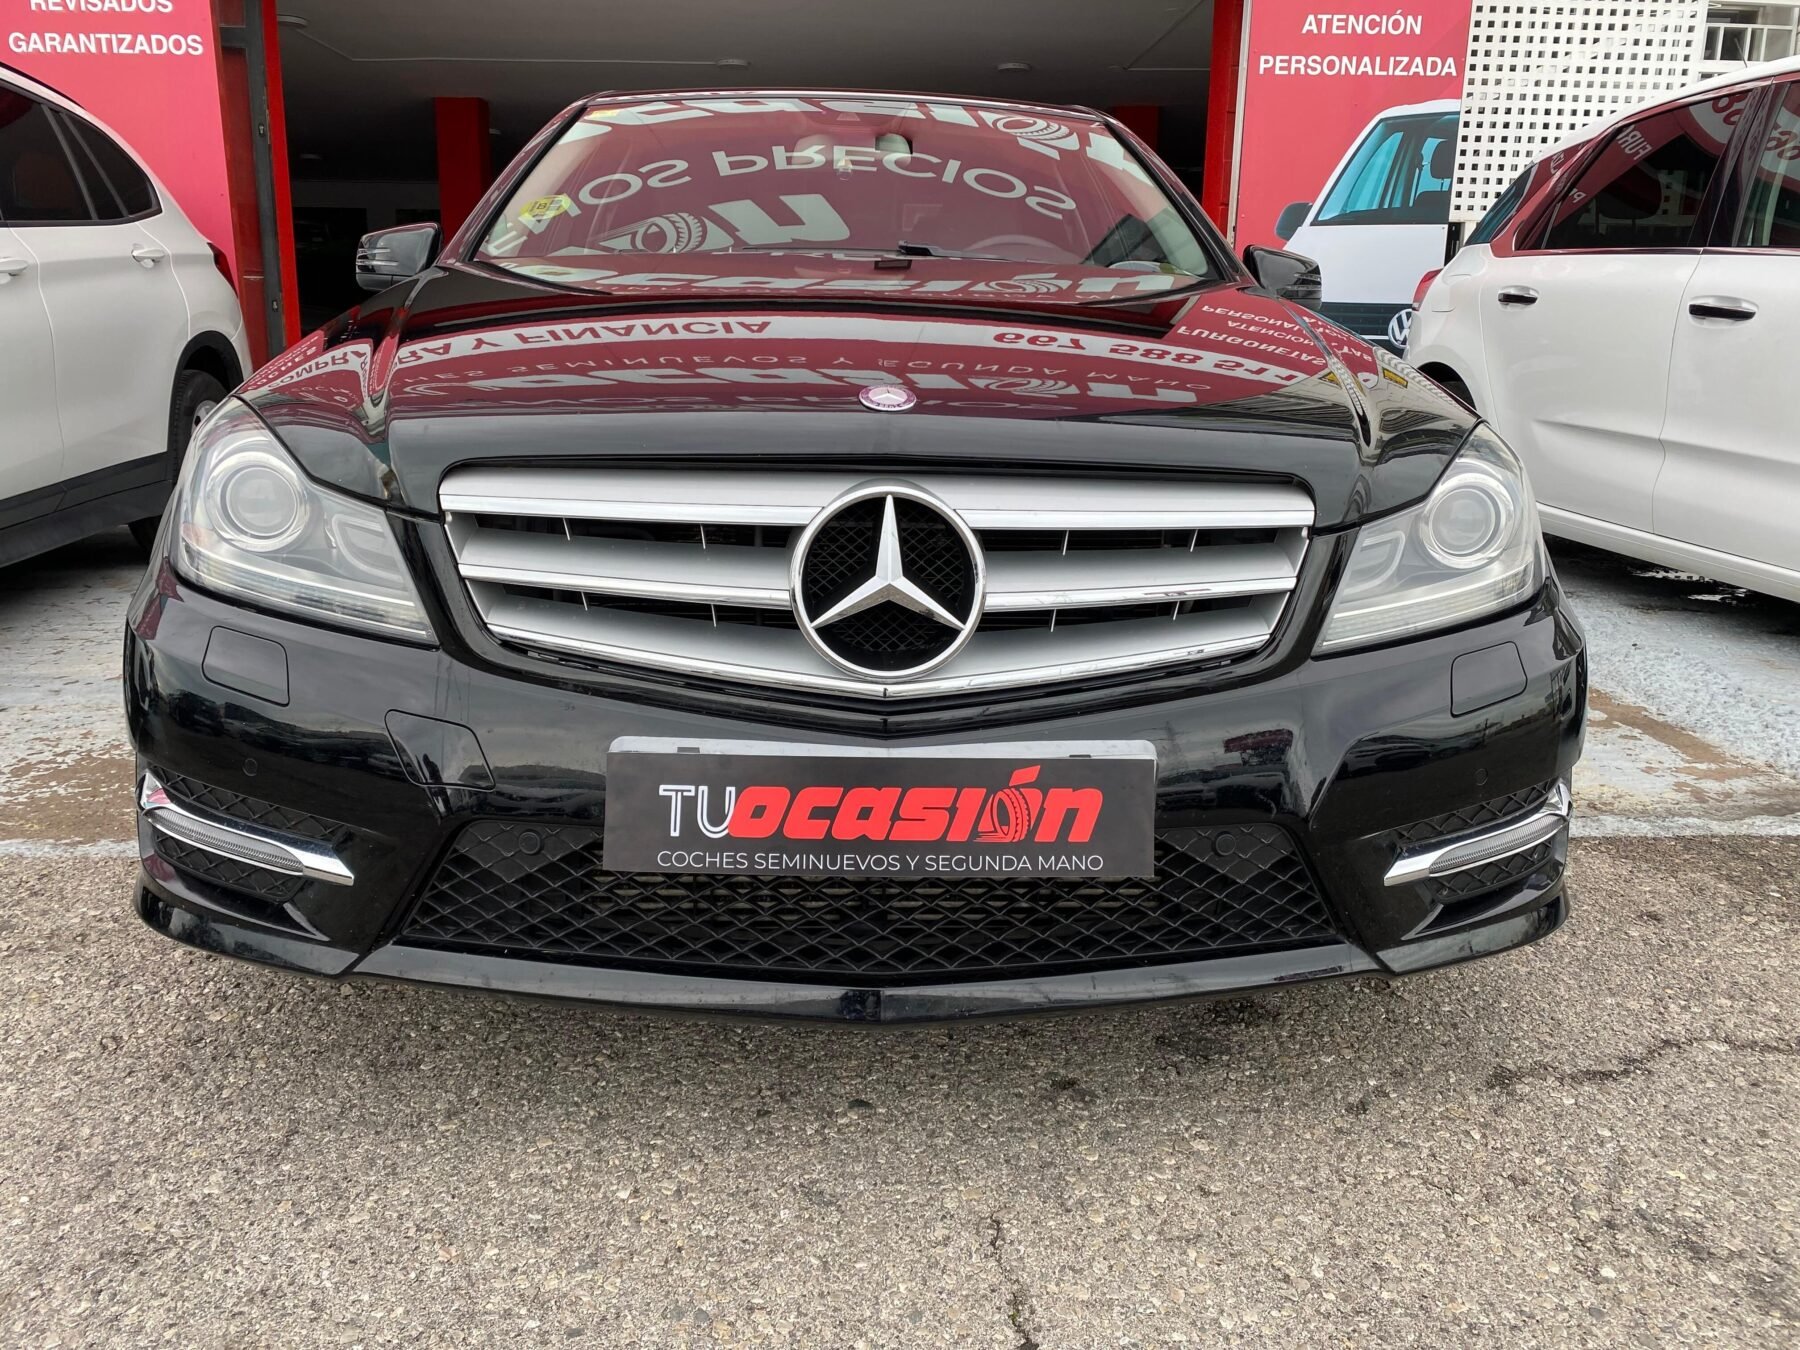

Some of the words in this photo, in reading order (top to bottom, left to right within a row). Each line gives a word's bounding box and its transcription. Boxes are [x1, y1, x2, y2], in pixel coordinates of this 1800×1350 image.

[1301, 9, 1422, 35] ATENCIÓN
[8, 32, 203, 55] GARANTIZADOS
[1259, 55, 1457, 76] PERSONALIZADA
[657, 850, 748, 869] COCHES
[754, 851, 901, 871] SEMINUEVOS
[905, 854, 921, 870] Y
[925, 854, 1033, 872] SEGUNDA
[1038, 854, 1104, 871] MANO
